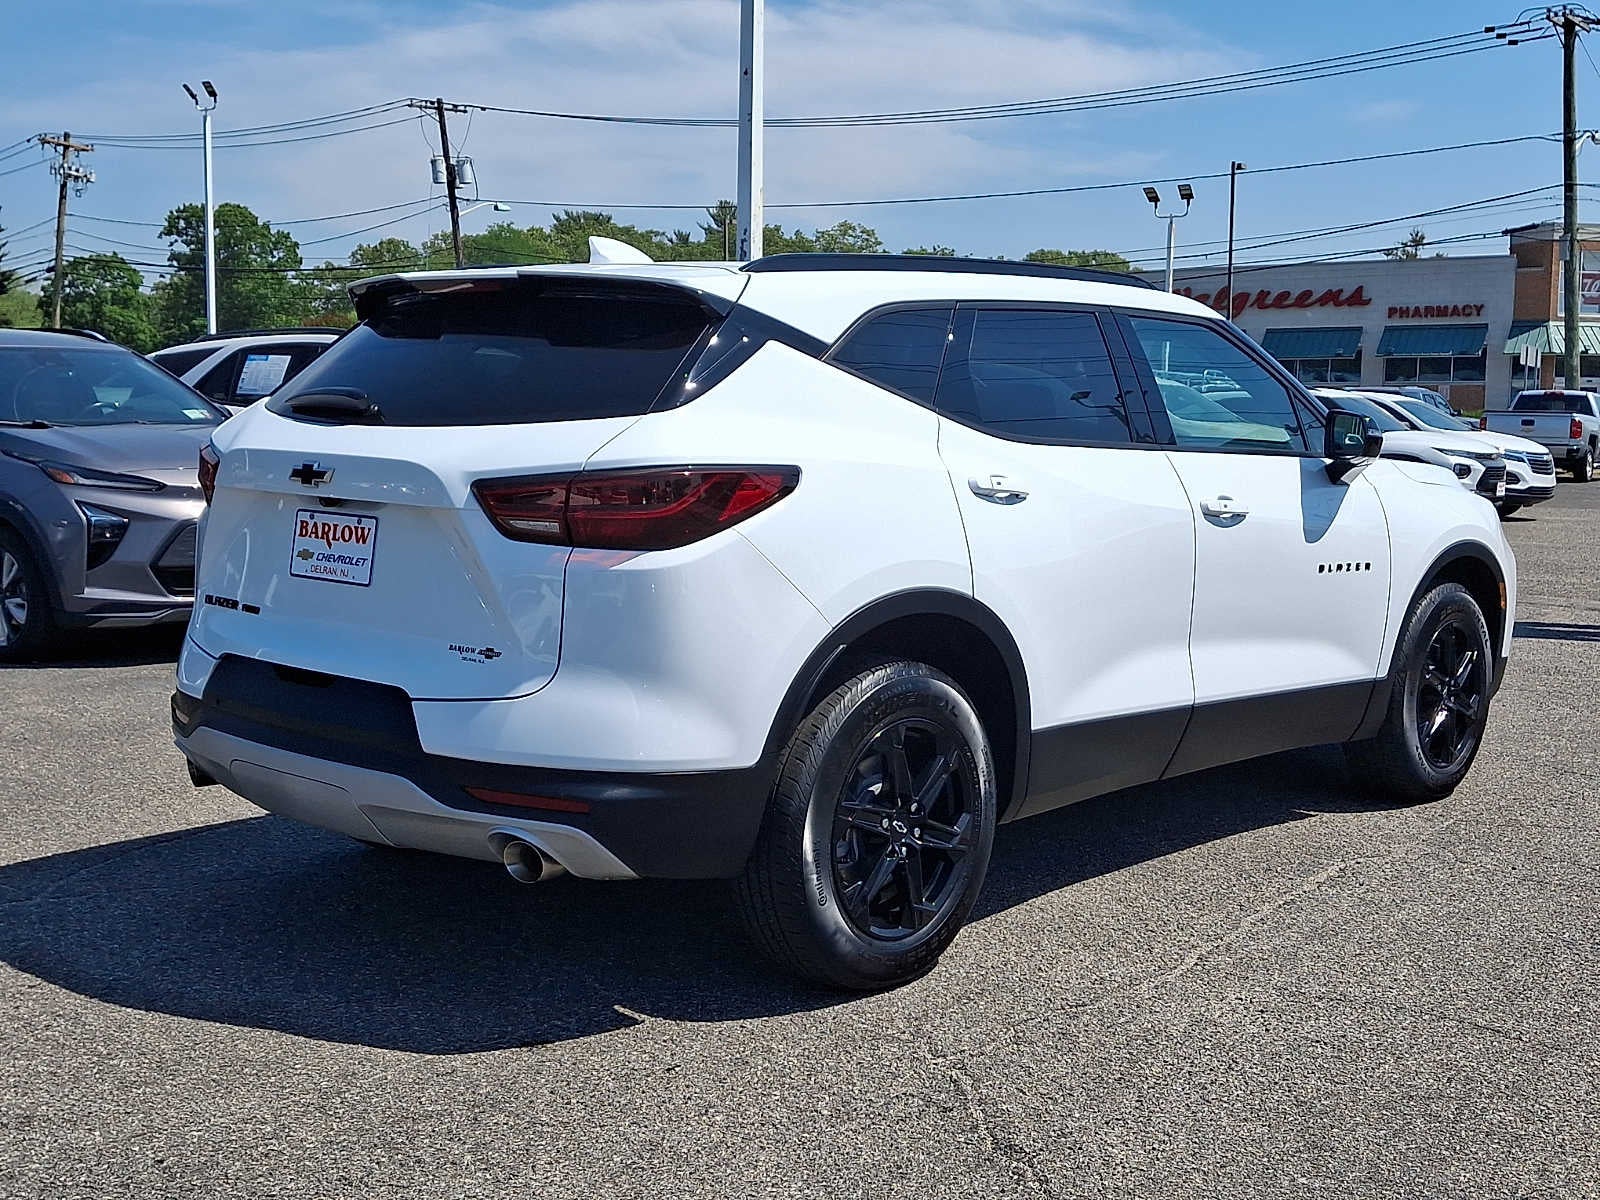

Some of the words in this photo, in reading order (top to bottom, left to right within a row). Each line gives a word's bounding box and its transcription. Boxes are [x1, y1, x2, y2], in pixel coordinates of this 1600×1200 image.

[1387, 304, 1484, 318] PHARMACY
[298, 519, 371, 550] BARLOW
[316, 552, 368, 567] CHEVROLET
[1318, 562, 1371, 573] BLAZER
